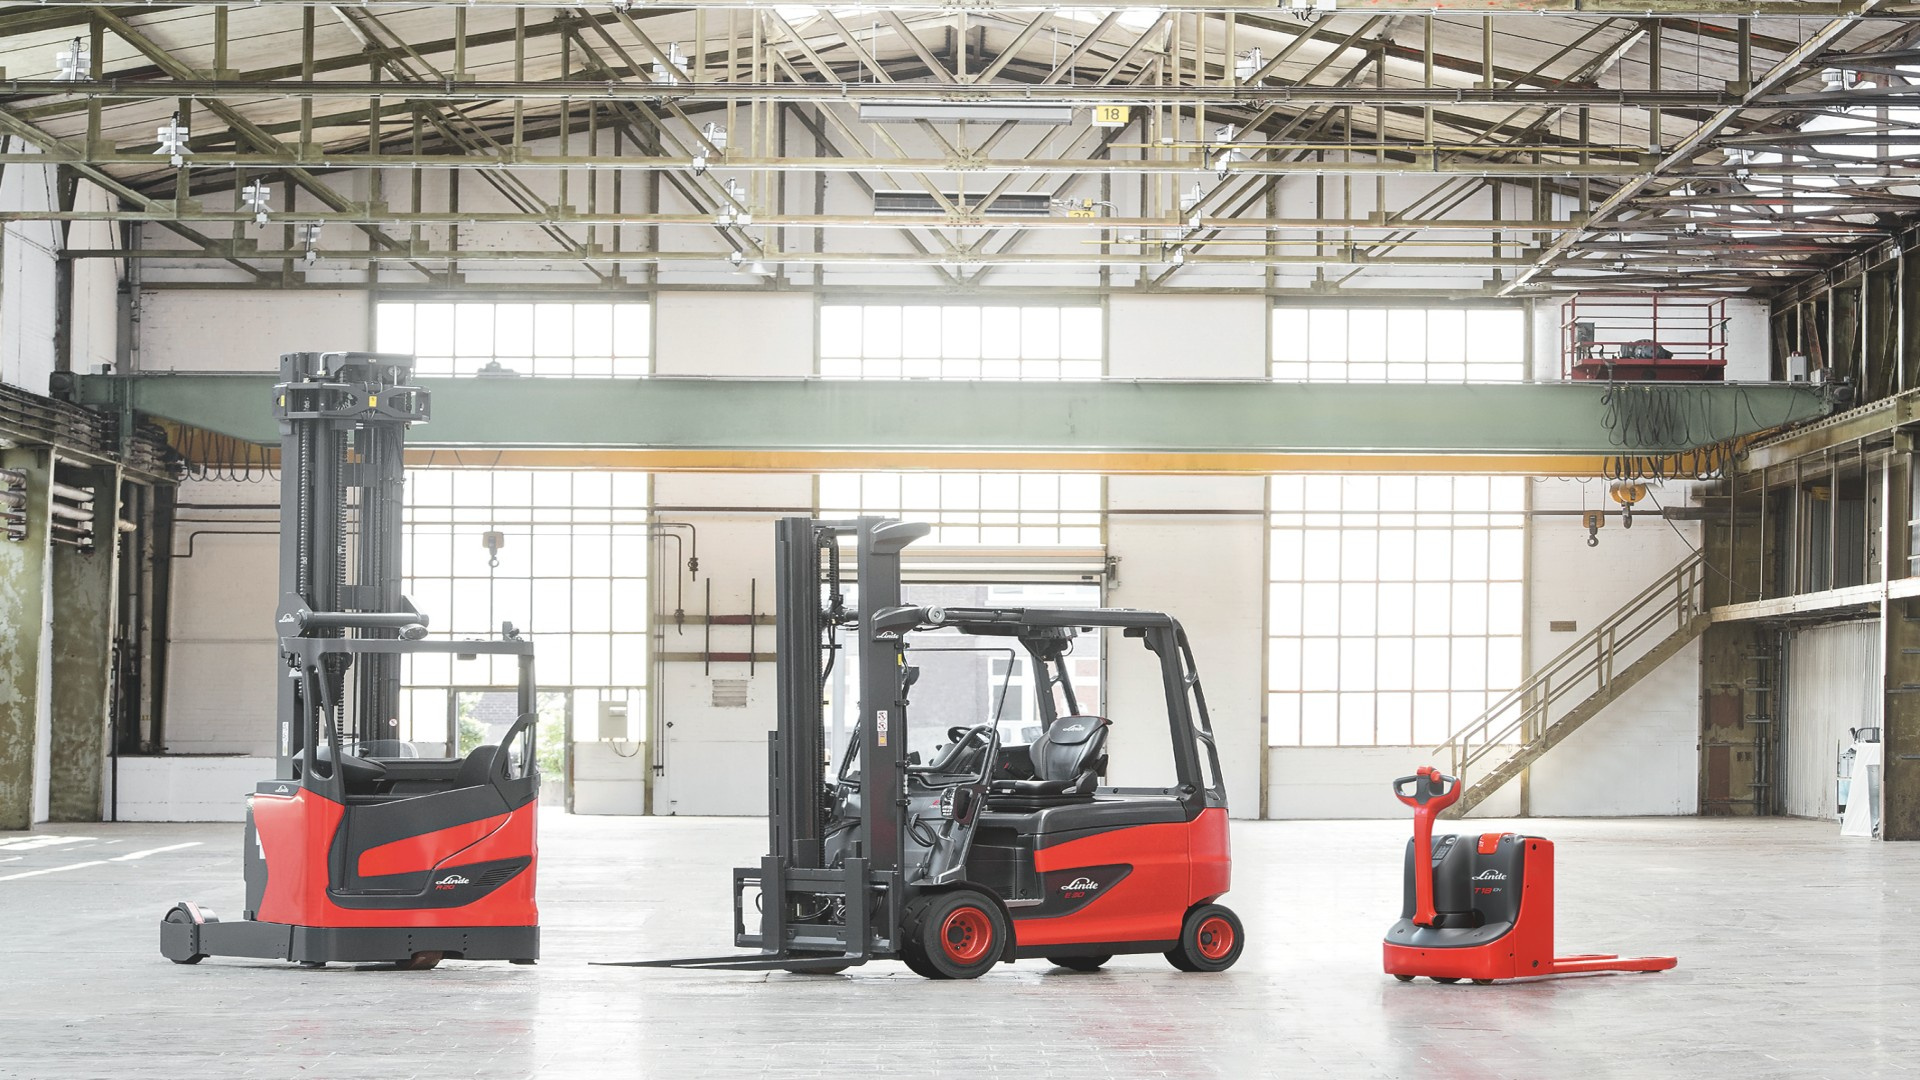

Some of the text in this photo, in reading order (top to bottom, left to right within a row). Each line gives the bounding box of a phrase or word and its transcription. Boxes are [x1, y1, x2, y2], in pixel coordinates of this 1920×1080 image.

[1104, 108, 1120, 120] 18
[435, 874, 470, 885] Linde
[1471, 869, 1507, 880] Linde
[1060, 877, 1099, 891] Linde
